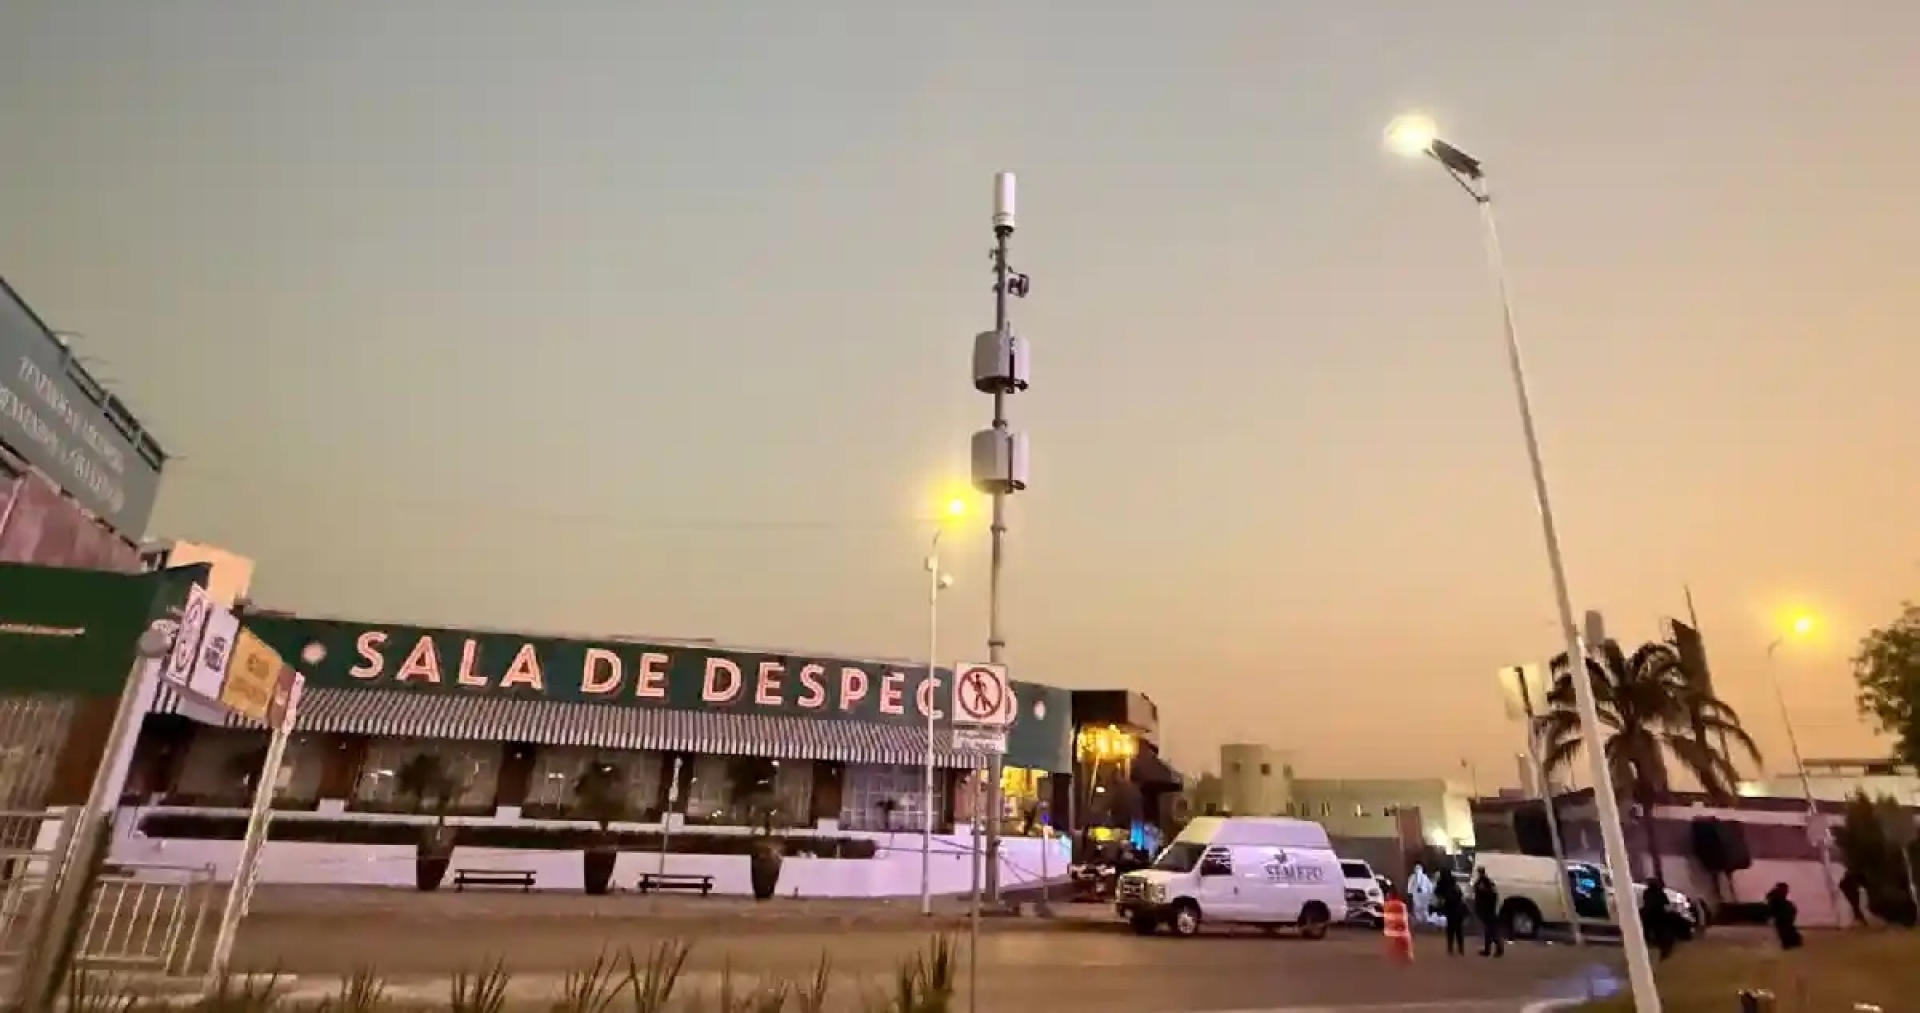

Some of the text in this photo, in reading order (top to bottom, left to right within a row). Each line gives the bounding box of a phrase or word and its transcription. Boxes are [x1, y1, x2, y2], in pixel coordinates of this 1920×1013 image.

[349, 630, 1018, 725] SALA DE DESPEC
